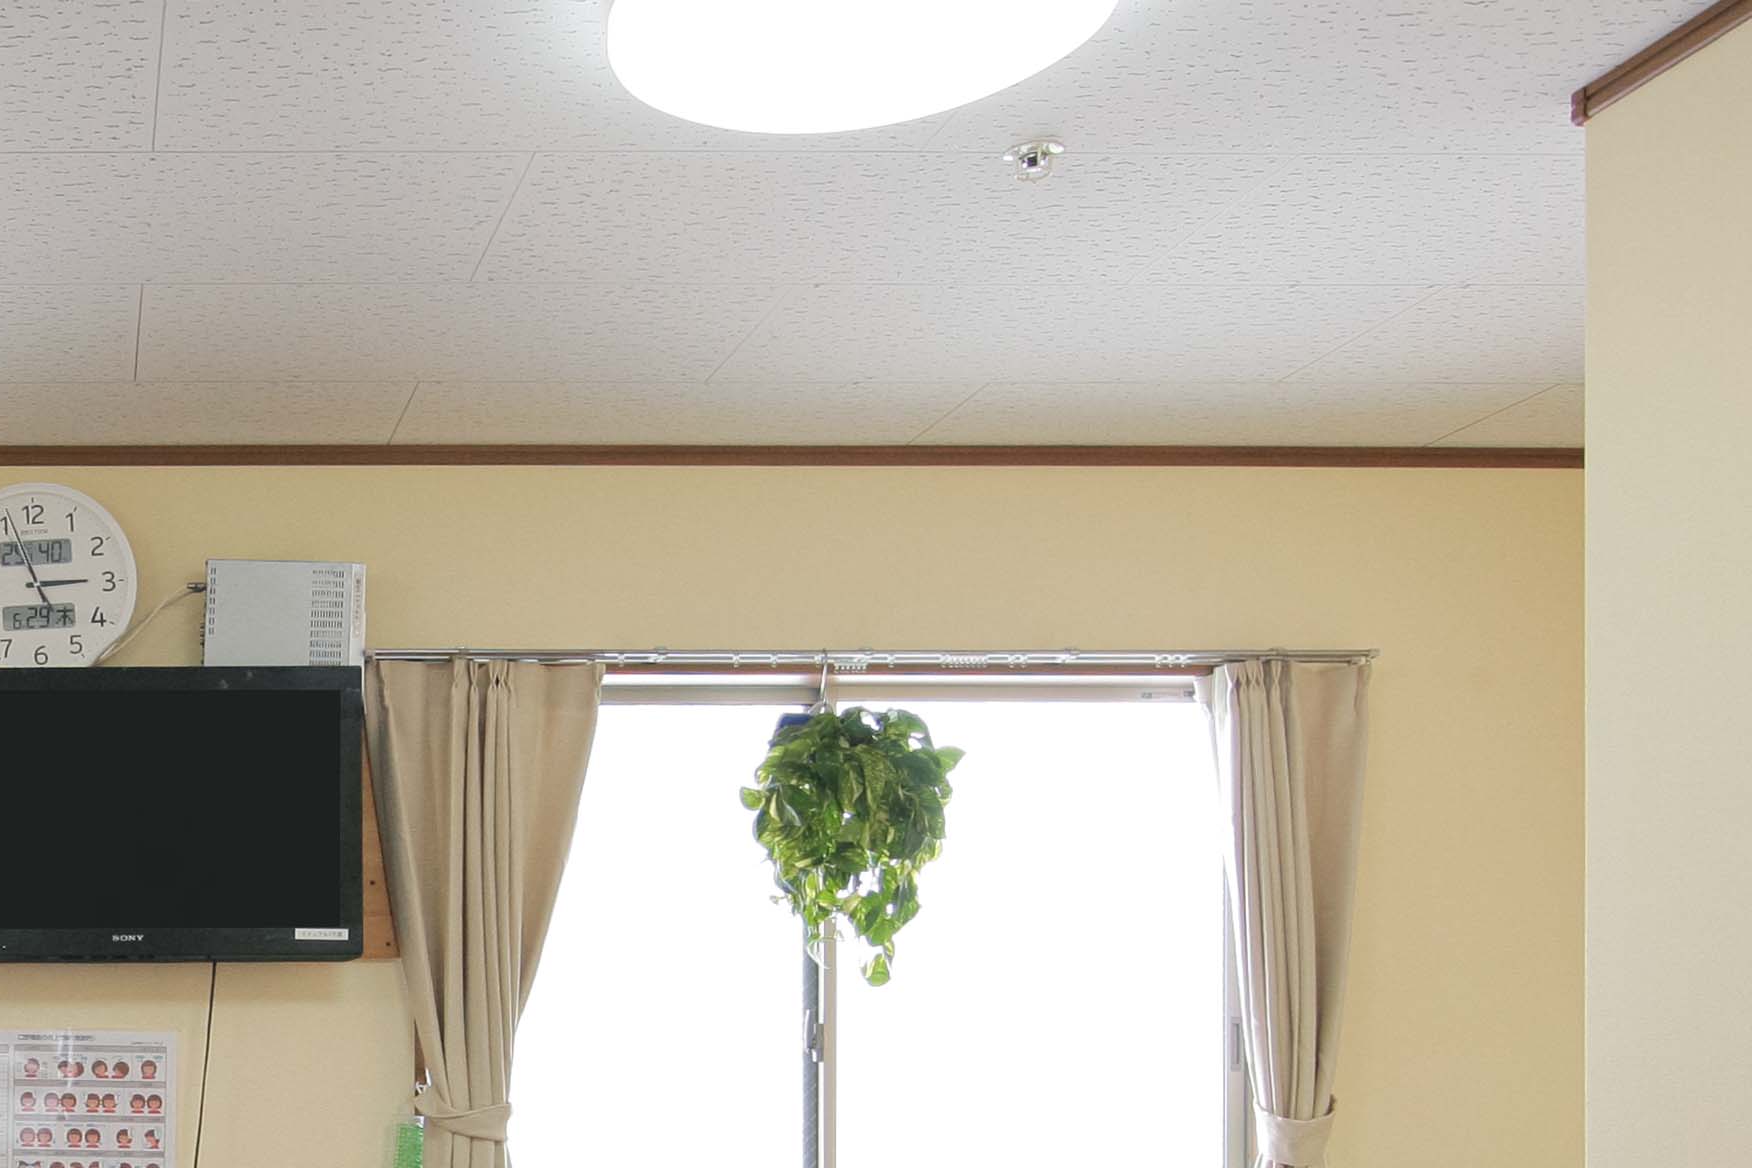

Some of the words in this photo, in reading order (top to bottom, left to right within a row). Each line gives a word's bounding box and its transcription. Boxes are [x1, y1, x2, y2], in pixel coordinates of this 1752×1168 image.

[22, 505, 44, 524] 12
[66, 513, 74, 532] 1
[91, 537, 103, 556] 2
[102, 572, 115, 591] 3
[56, 606, 73, 626] 木
[91, 607, 106, 627] 4
[0, 640, 13, 658] 7
[70, 635, 82, 654] 5
[34, 646, 48, 665] 6
[112, 934, 144, 942] SONY
